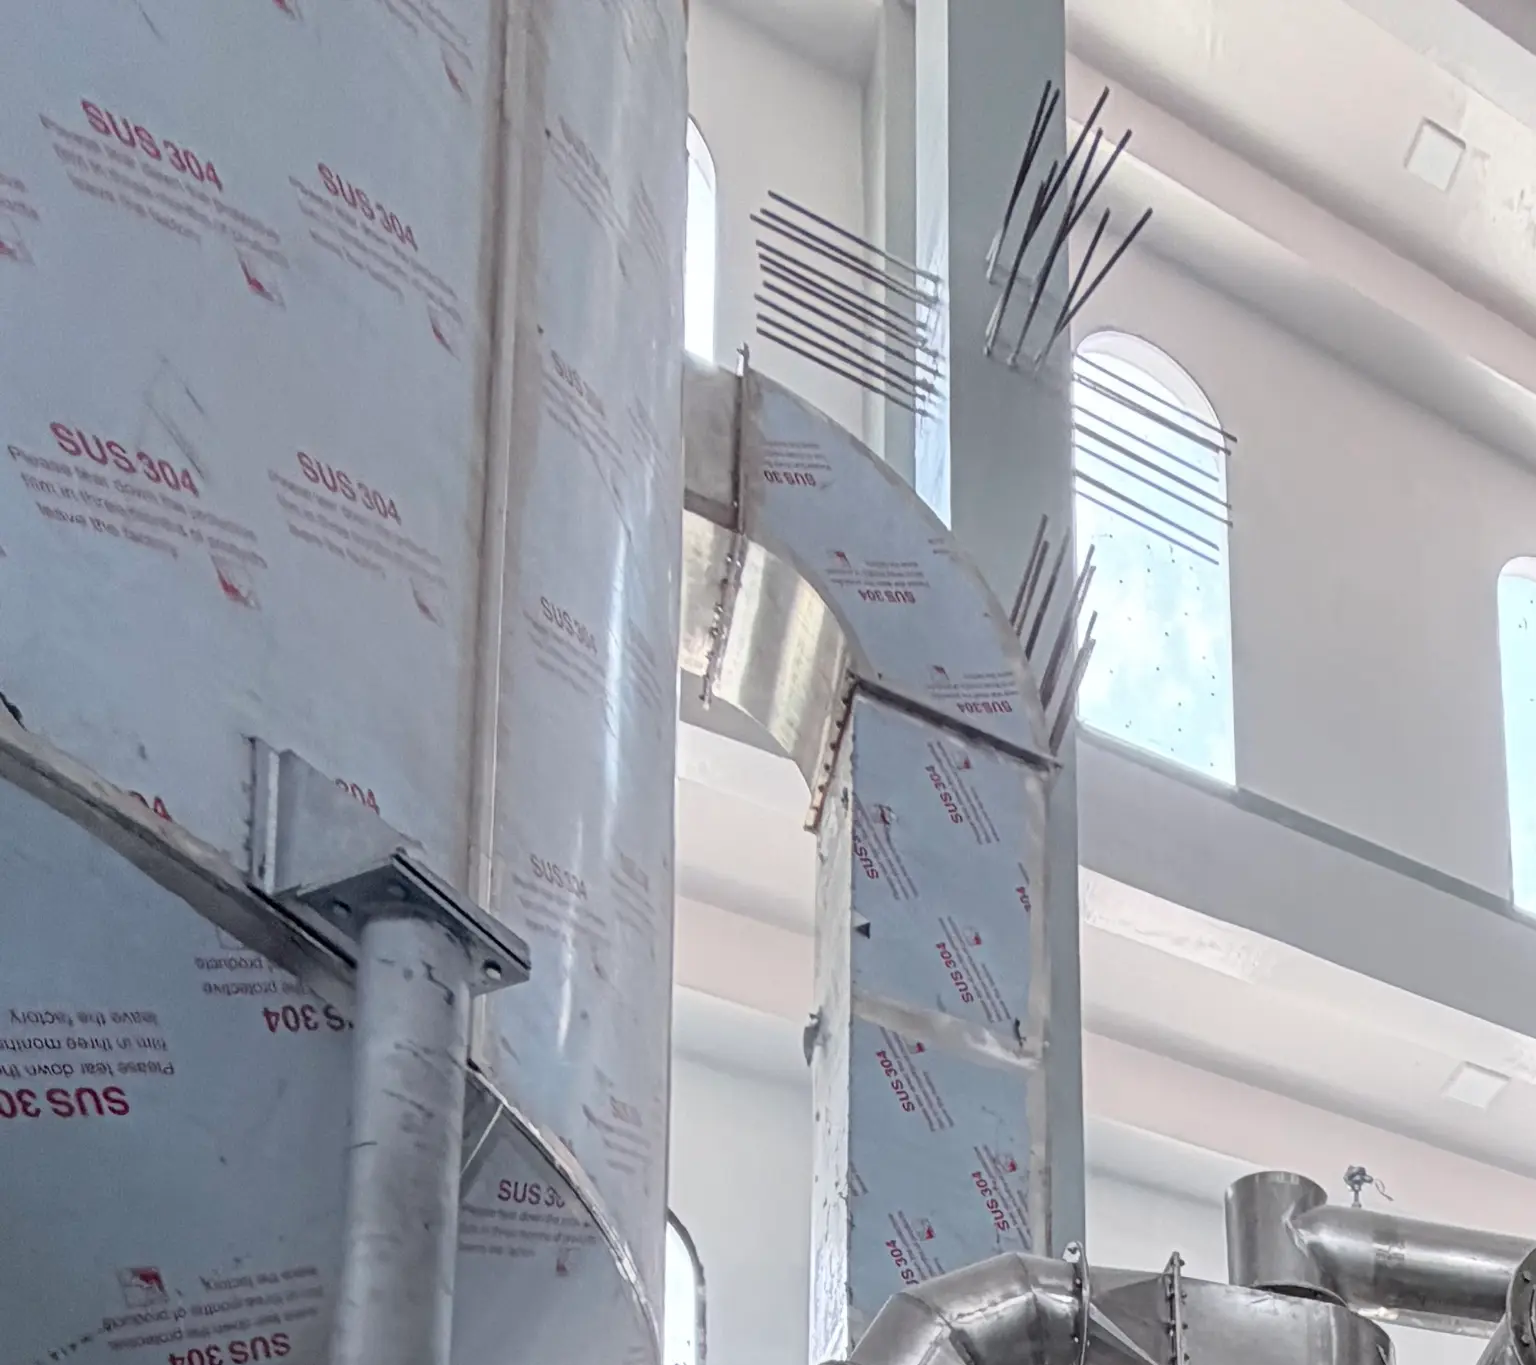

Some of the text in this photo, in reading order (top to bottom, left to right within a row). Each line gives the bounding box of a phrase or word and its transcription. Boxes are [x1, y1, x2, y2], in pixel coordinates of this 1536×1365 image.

[81, 99, 223, 192] SUS 304
[50, 421, 200, 498] SUS 304
[297, 451, 402, 526] SUS 304
[939, 791, 965, 825] SUS
[853, 844, 880, 881] SUS
[949, 969, 975, 1005] SUS
[262, 1003, 319, 1034] 304
[24, 1061, 75, 1079] down
[874, 1049, 916, 1113] SUS 304
[0, 1085, 131, 1120] SUS 30
[497, 1178, 542, 1206] SUS
[970, 1170, 1011, 1232] SUS 304
[884, 1239, 909, 1269] 304
[227, 1331, 292, 1365] SUS
